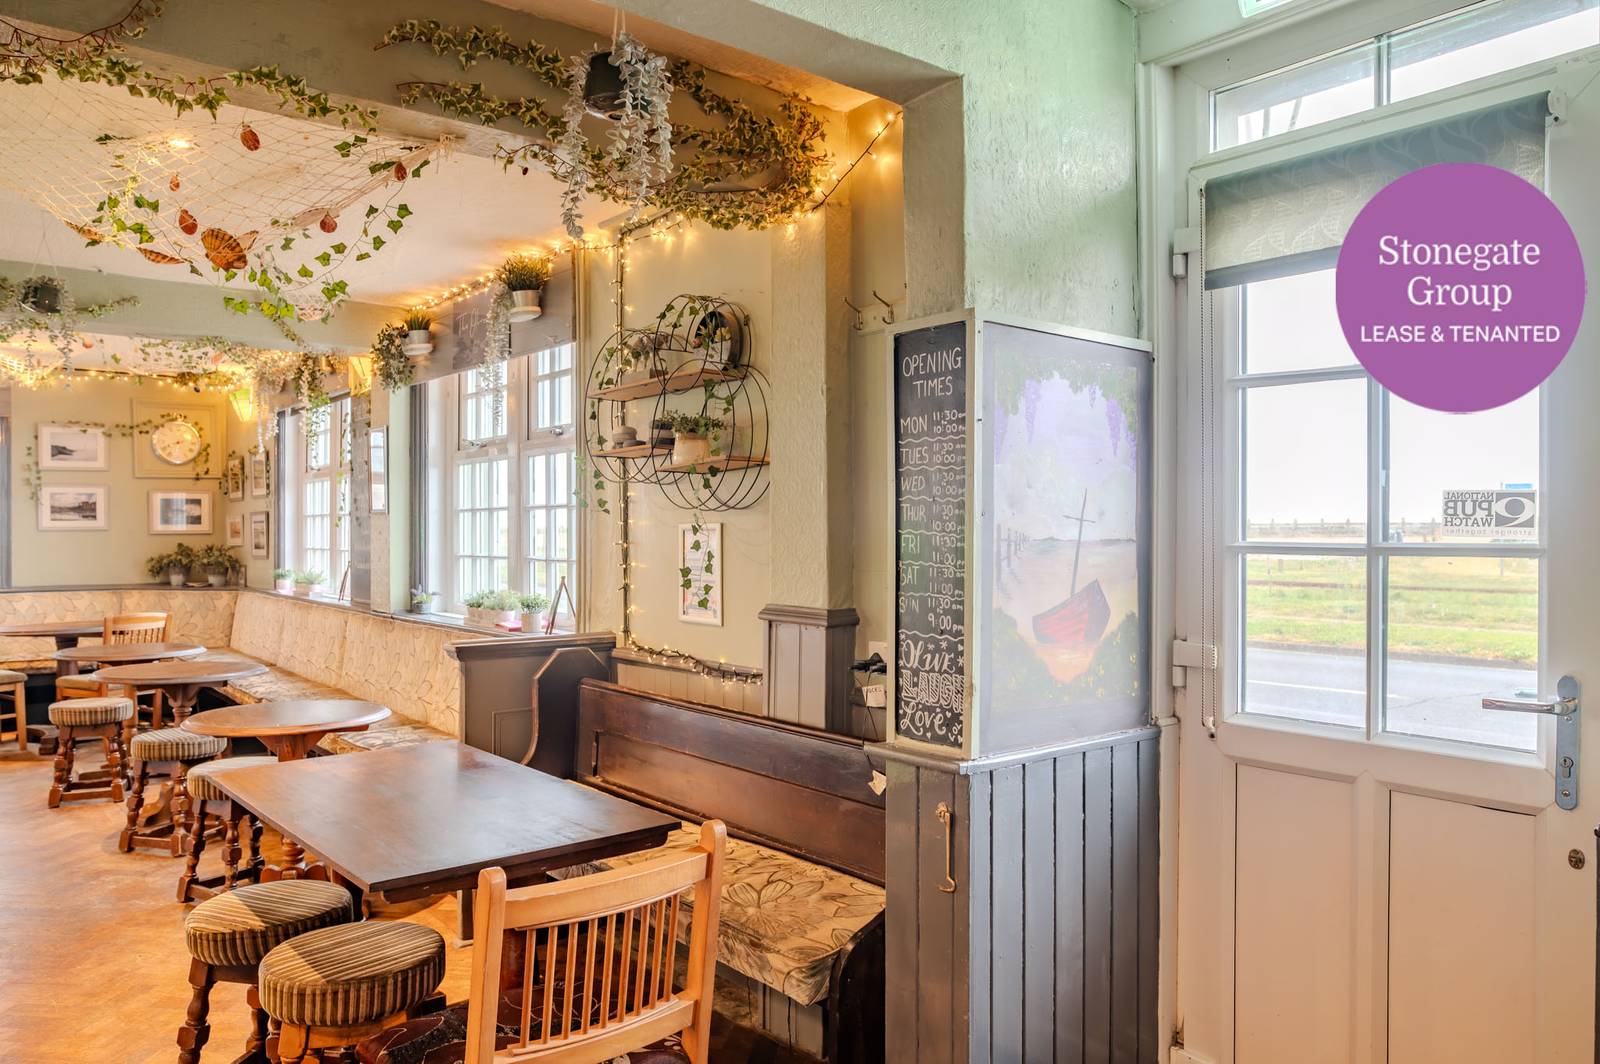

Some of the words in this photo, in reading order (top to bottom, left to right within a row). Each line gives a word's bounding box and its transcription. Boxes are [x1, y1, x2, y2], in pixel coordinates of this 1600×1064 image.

[902, 347, 962, 377] OPENING
[912, 376, 953, 399] TIMES
[900, 414, 928, 434] MON
[900, 446, 929, 465] TUES
[901, 475, 926, 492] WED
[900, 503, 927, 523] THUR
[901, 534, 920, 553] FRI
[900, 565, 920, 586] SAT
